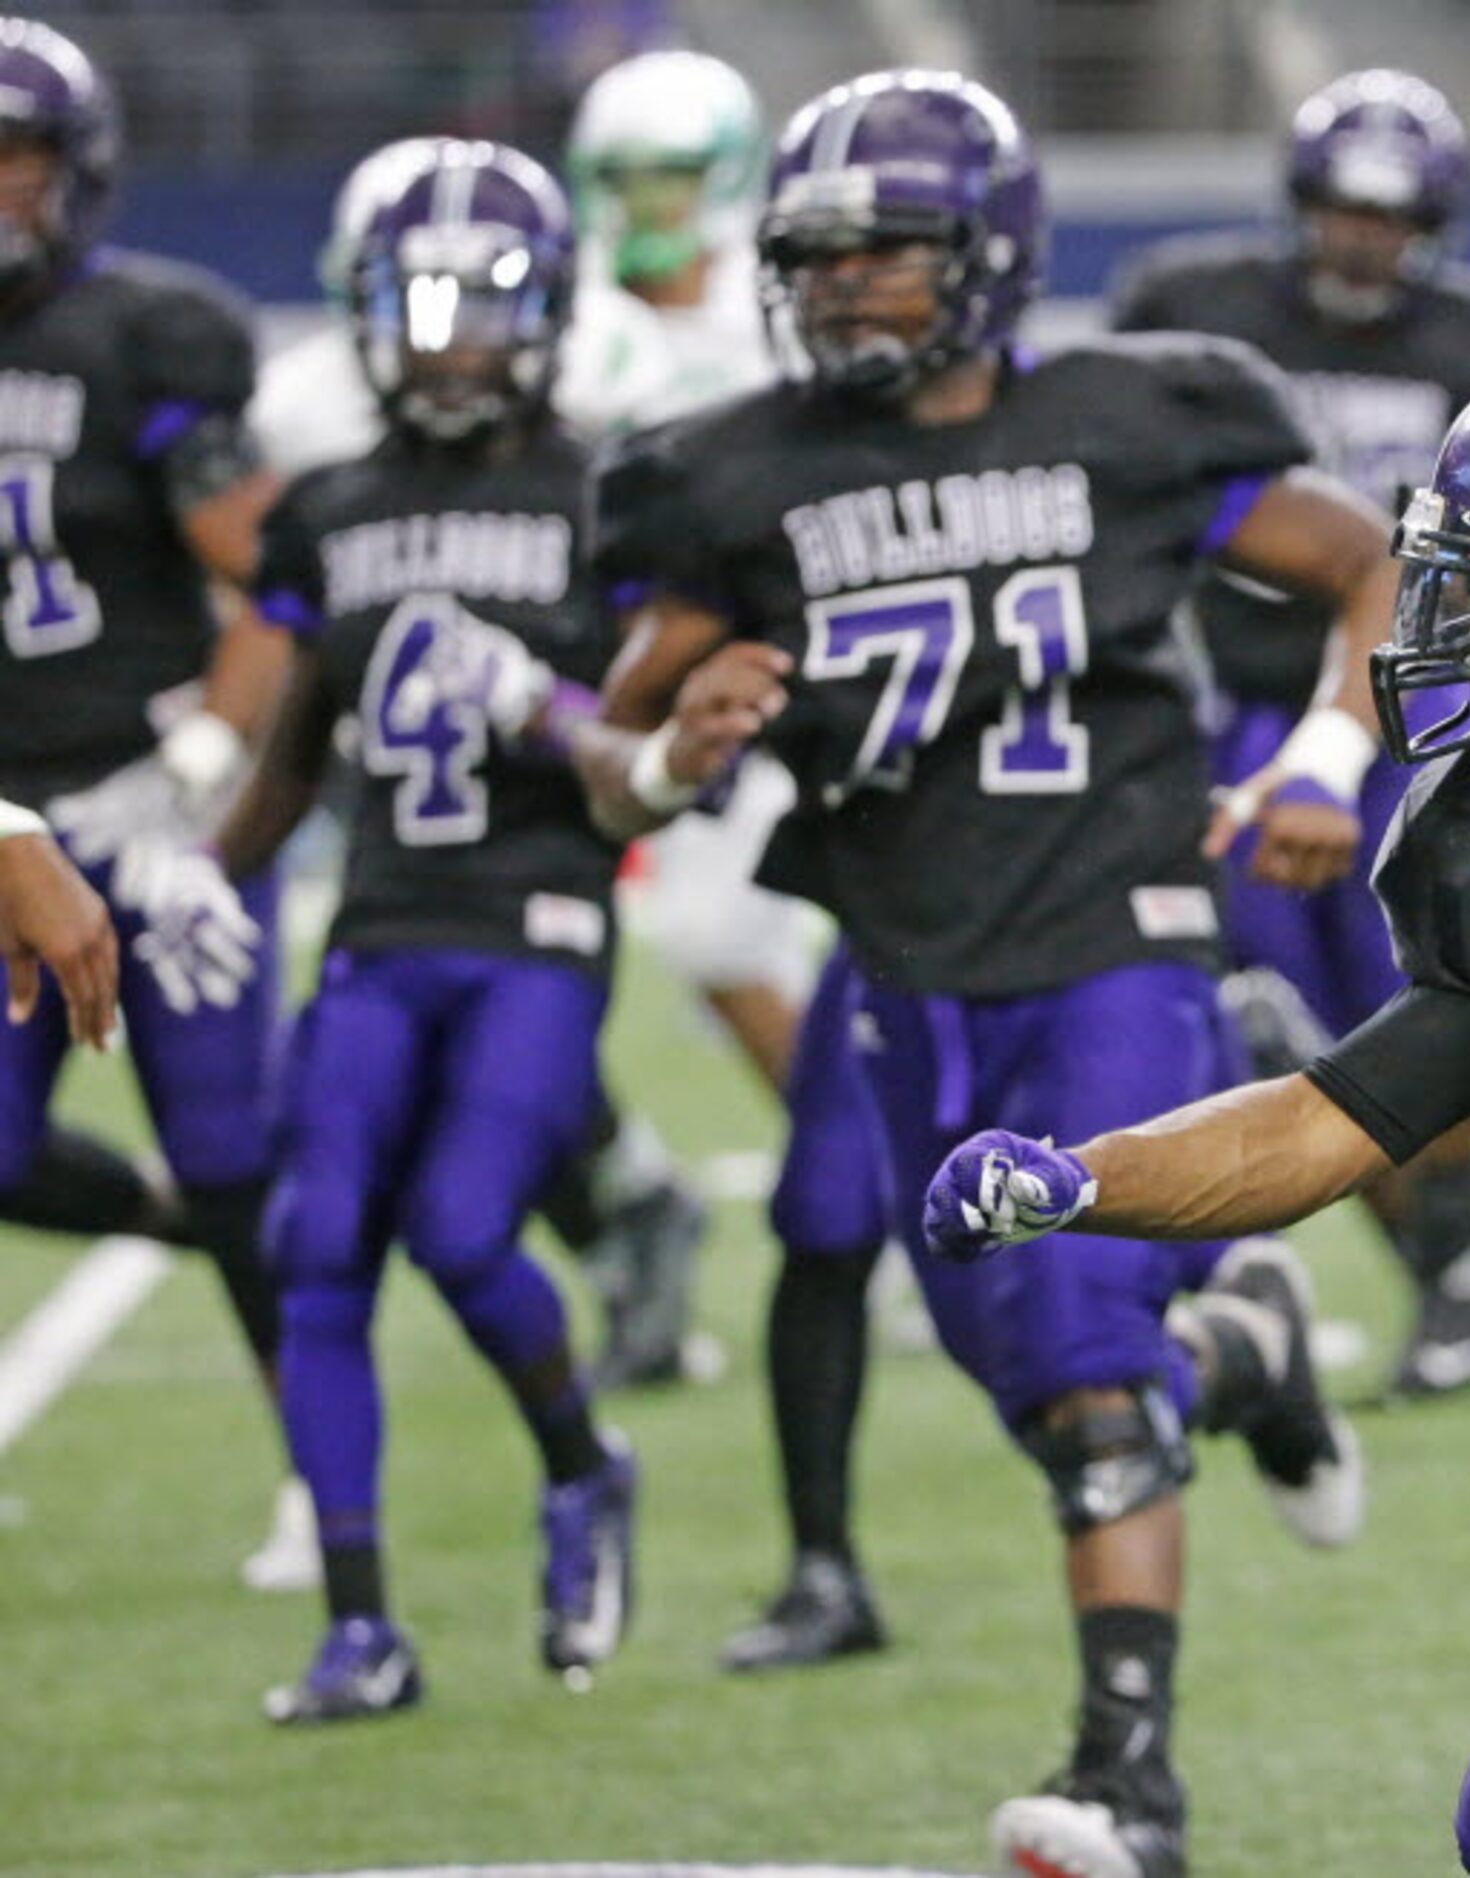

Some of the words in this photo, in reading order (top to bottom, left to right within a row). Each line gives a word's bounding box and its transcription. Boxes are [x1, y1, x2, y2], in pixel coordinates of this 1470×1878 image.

[782, 463, 1094, 597] BULLDOGS
[360, 592, 490, 846] 4
[803, 565, 1089, 804] 71
